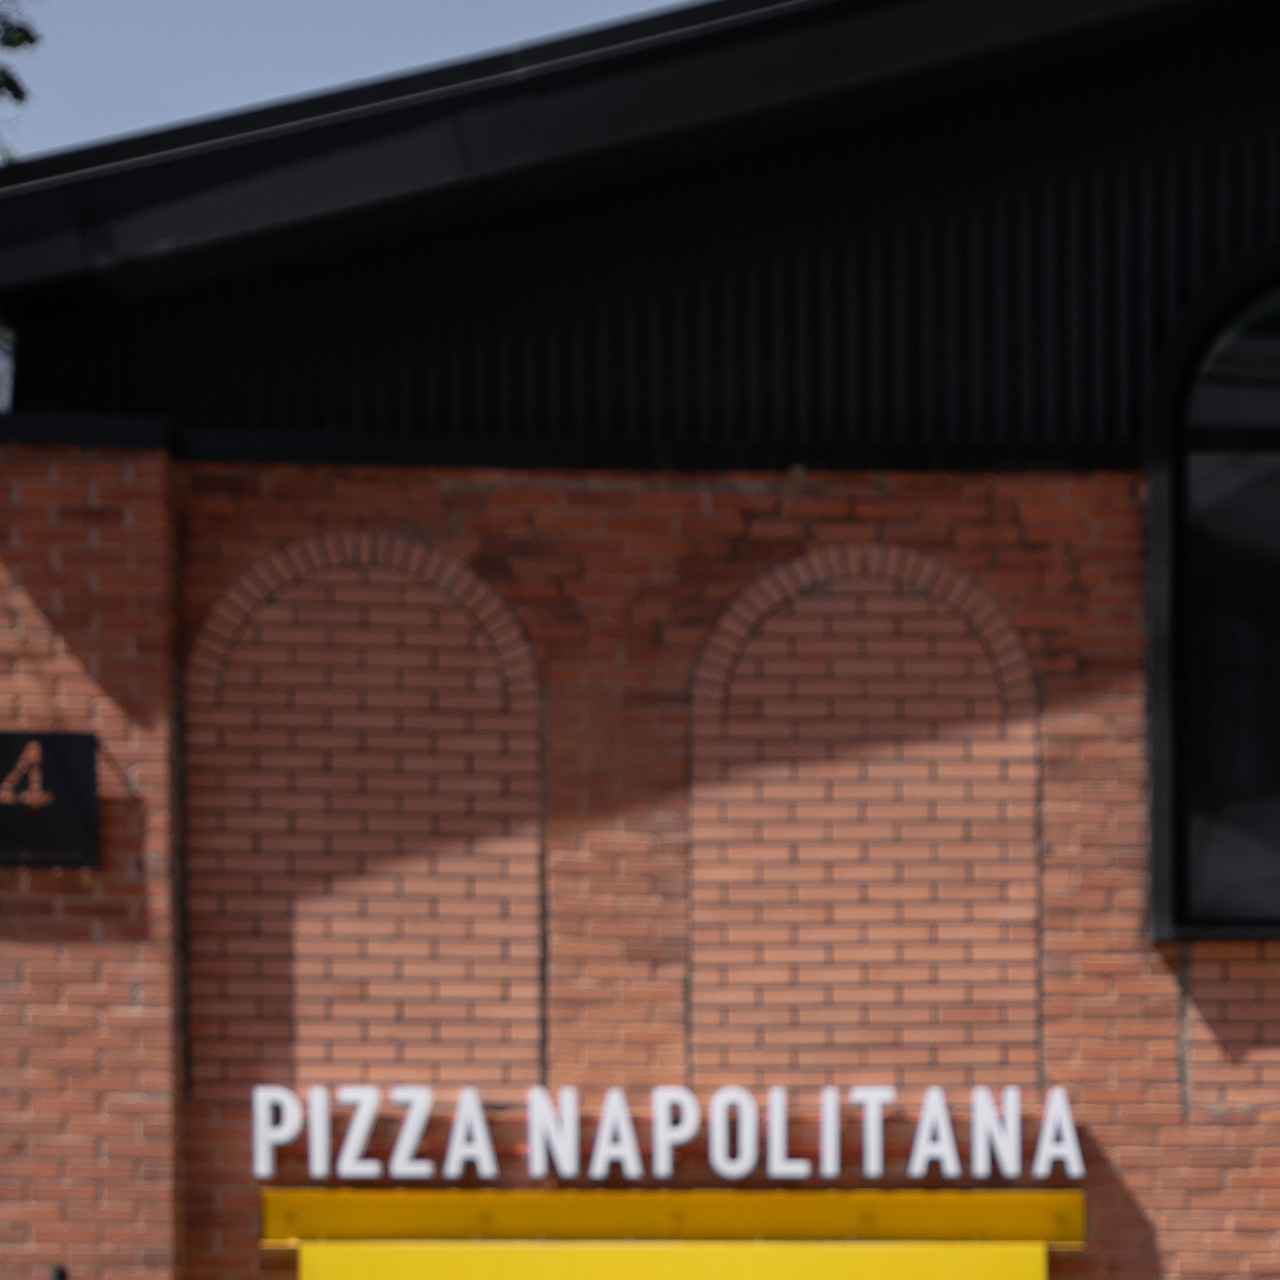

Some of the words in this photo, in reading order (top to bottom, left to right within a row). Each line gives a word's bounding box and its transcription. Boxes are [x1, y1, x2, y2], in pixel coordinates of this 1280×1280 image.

[0, 740, 53, 812] 4
[251, 1084, 500, 1180] PIZZA
[526, 1084, 1087, 1180] NAPOLITANA
